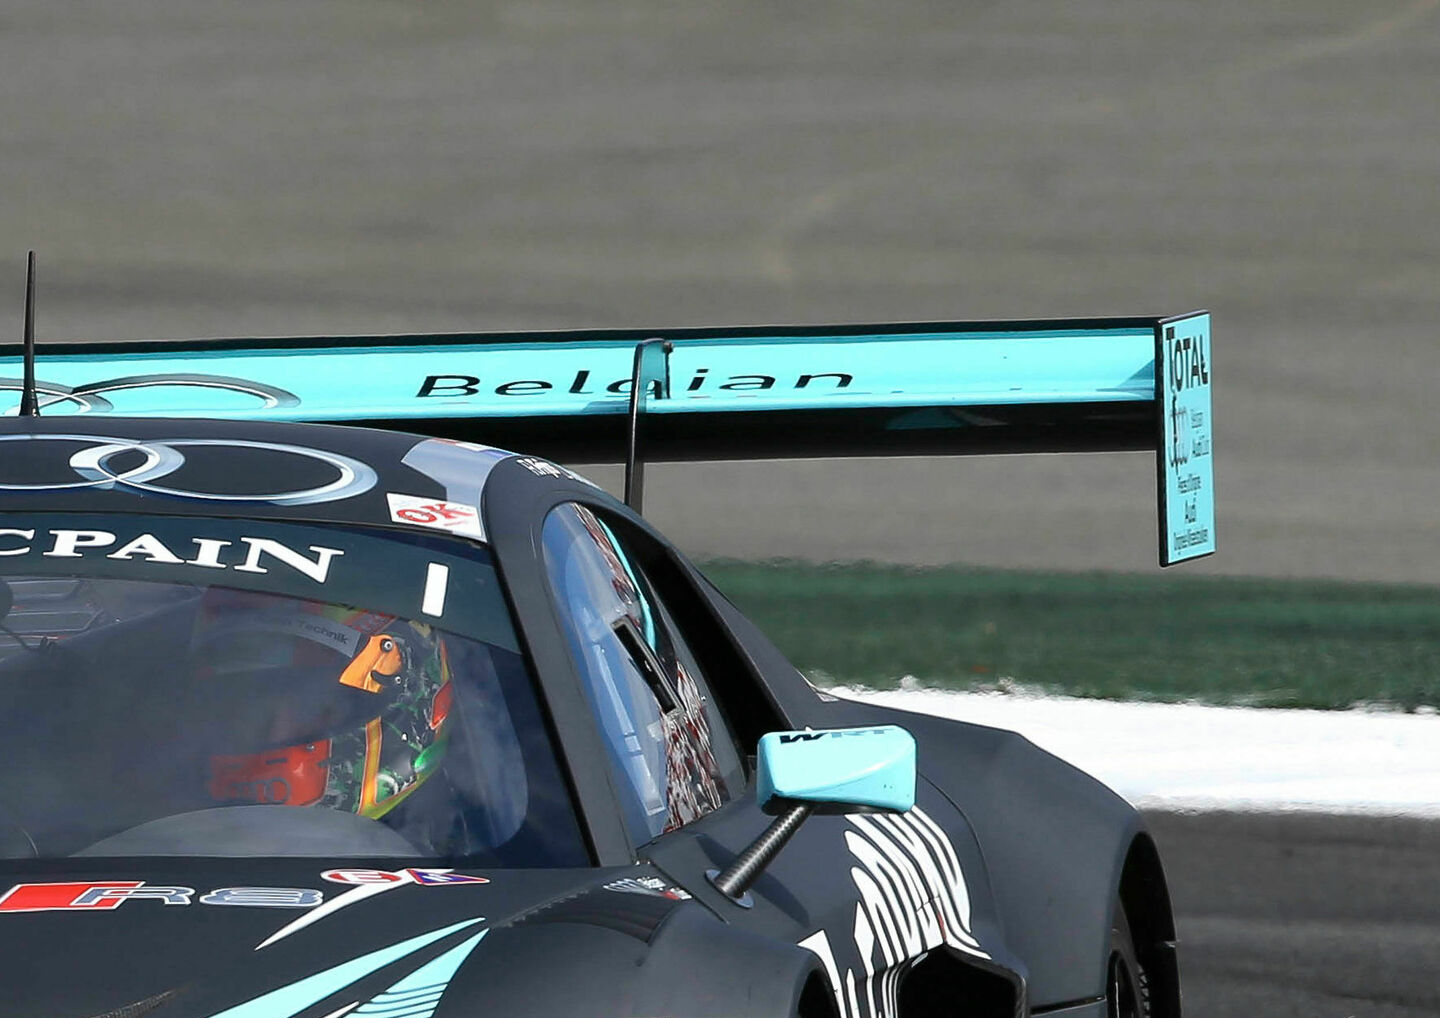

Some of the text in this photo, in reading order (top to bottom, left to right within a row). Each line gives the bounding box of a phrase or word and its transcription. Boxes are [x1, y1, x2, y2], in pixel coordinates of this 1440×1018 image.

[1165, 326, 1209, 393] TOTAL
[297, 619, 348, 645] Technik
[72, 886, 324, 908] R8
